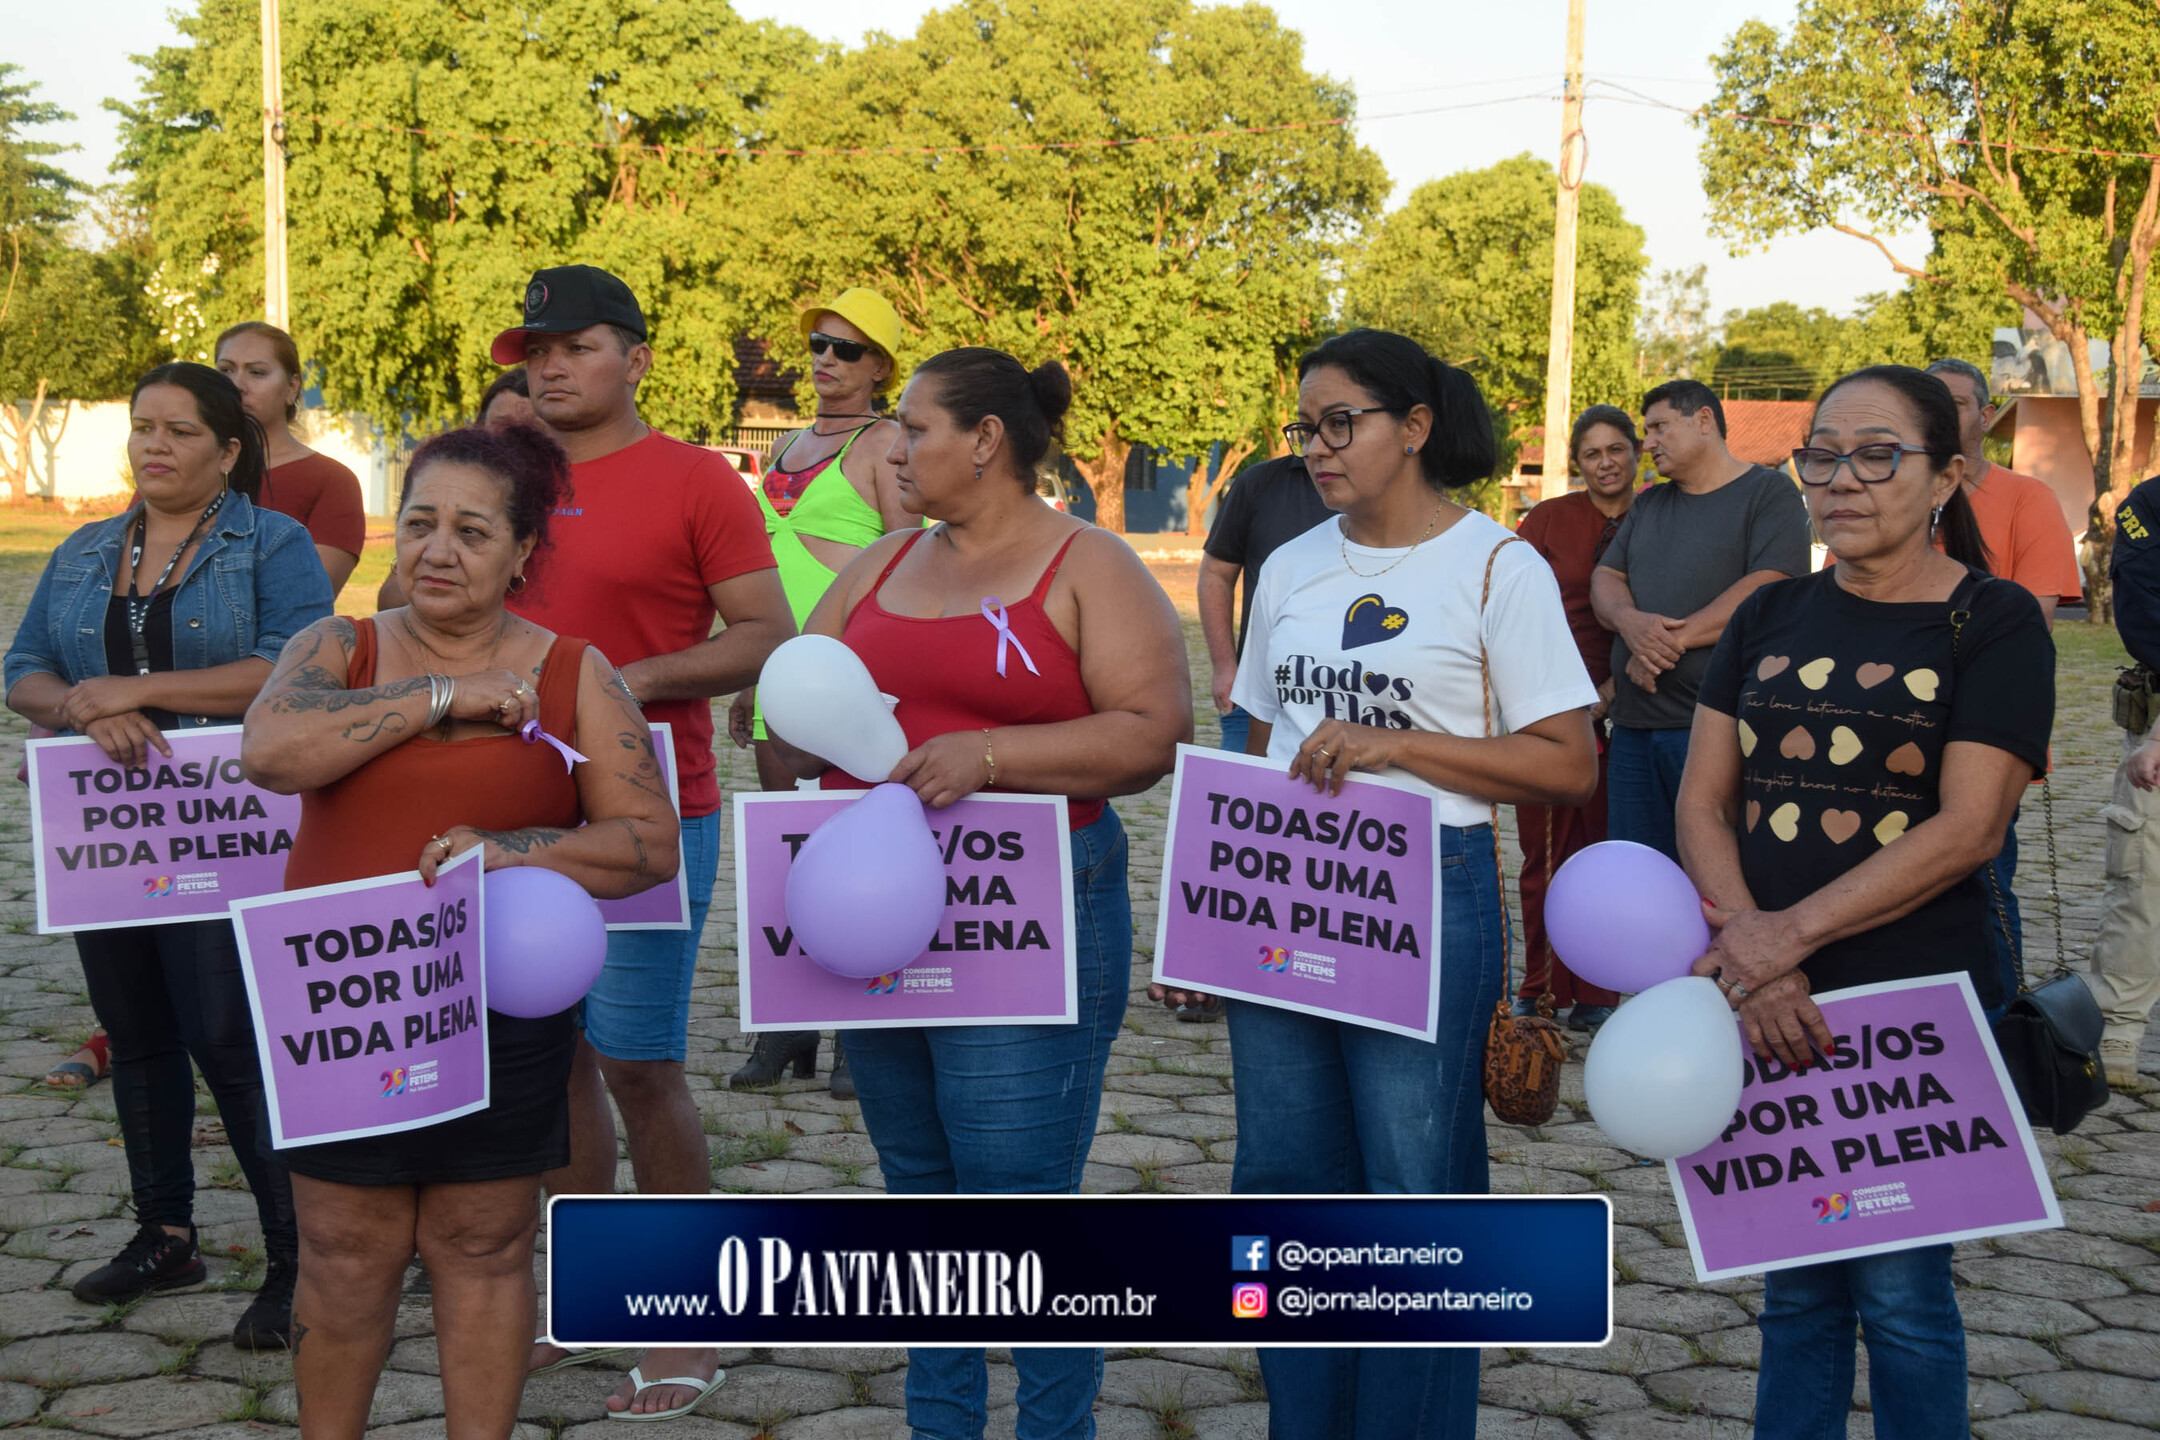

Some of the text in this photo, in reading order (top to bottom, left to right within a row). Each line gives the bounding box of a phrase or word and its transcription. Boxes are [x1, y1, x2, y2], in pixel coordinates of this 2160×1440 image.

[2117, 505, 2150, 540] PRF
[1276, 686, 1321, 709] por
[1769, 695, 1801, 710] love
[1807, 699, 1861, 719] between
[1892, 710, 1936, 731] mother
[68, 756, 247, 796] TODAS/O
[1800, 774, 1837, 792] knows
[1843, 785, 1867, 794] no
[1870, 780, 1924, 803] distance
[82, 794, 268, 832] POR UMA
[1207, 792, 1408, 858] TODAS/OS
[55, 829, 294, 871] VIDA PLENA
[1210, 840, 1397, 905] POR UMA
[283, 898, 467, 967] TODAS/OS
[928, 919, 1051, 952] LENA
[1180, 881, 1421, 959] VIDA PLENA
[306, 951, 464, 1014] POR UMA
[903, 967, 952, 975] CONGRESSO
[903, 978, 953, 988] FETEMS
[281, 995, 478, 1066] VIDA PLENA
[1831, 1072, 1955, 1120] UMA
[1692, 1116, 2009, 1197] VIDA PLENA
[1851, 1181, 1906, 1197] CONGRESSO
[1856, 1193, 1912, 1211] FETEMS
